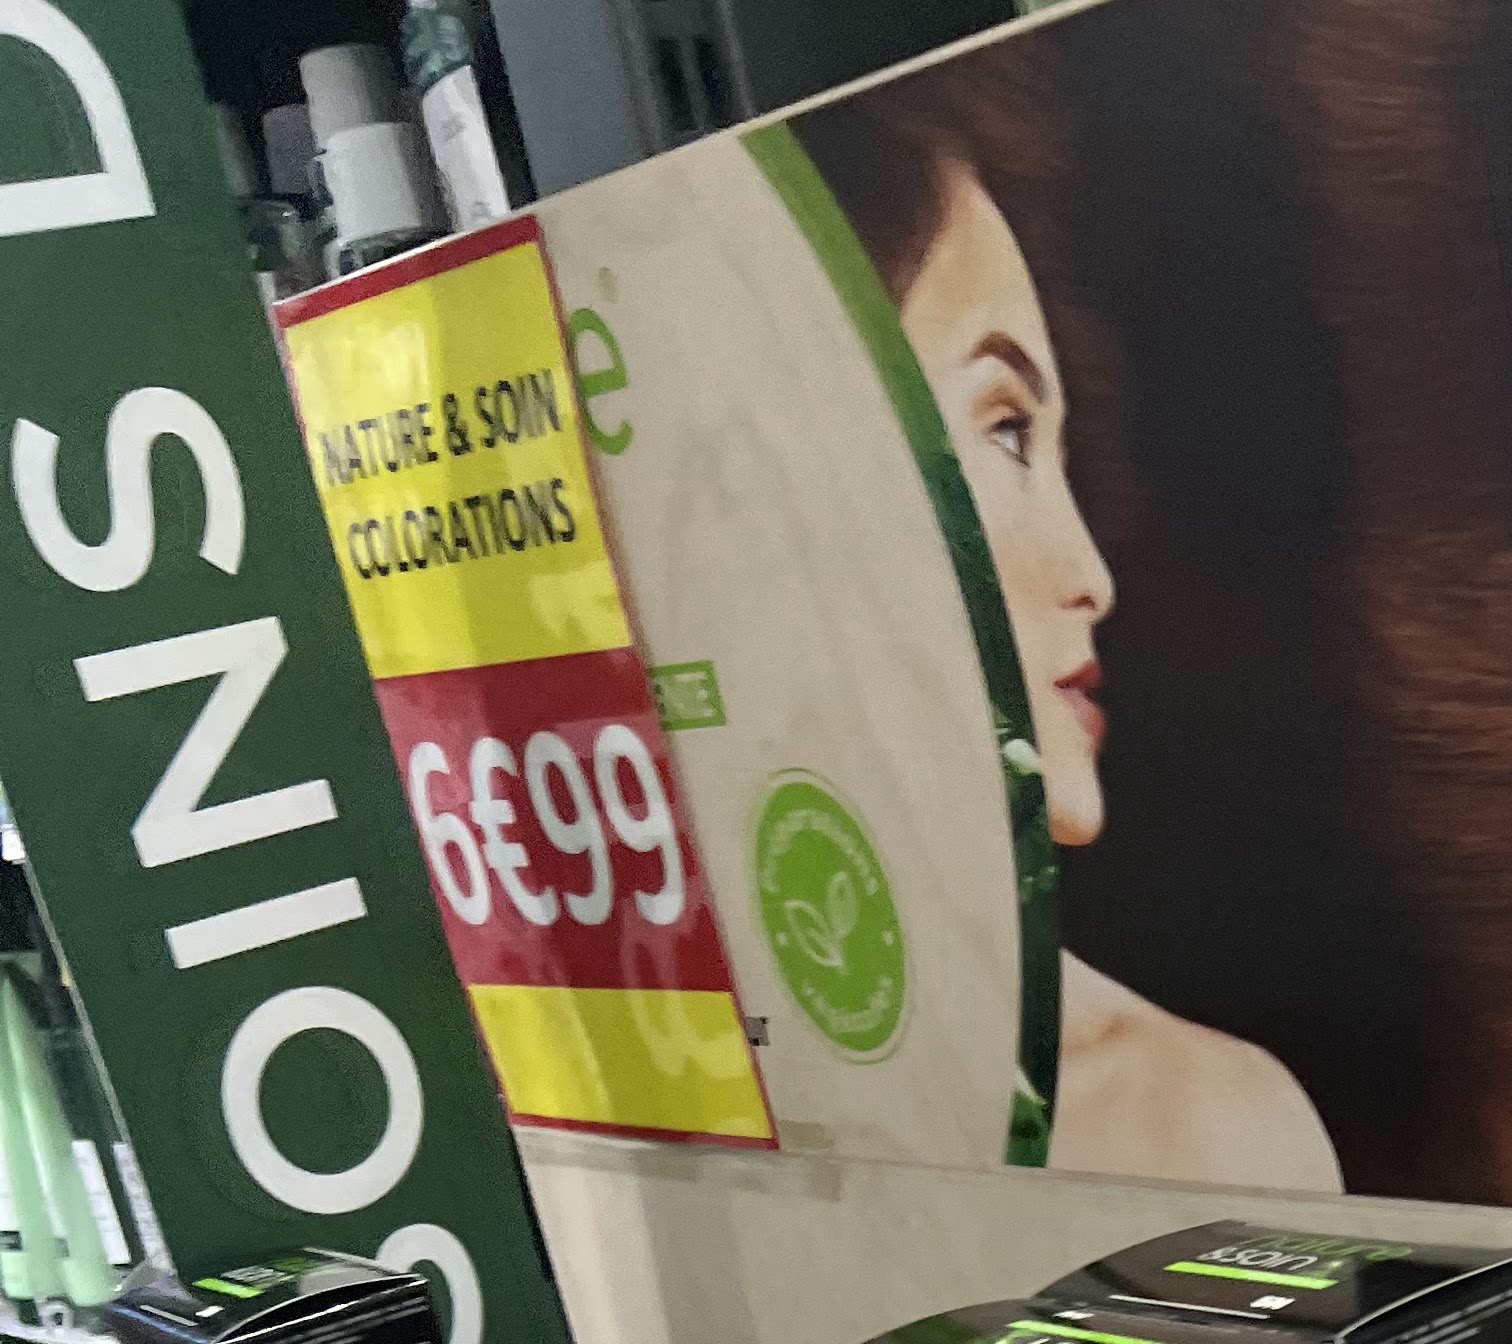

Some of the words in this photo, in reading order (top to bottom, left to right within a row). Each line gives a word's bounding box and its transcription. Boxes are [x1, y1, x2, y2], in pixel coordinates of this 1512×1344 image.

[318, 402, 439, 487] NATURE
[441, 393, 473, 457] &
[474, 369, 563, 448] SOIN
[347, 476, 577, 580] COLORATIONS
[408, 724, 686, 936] 6€99
